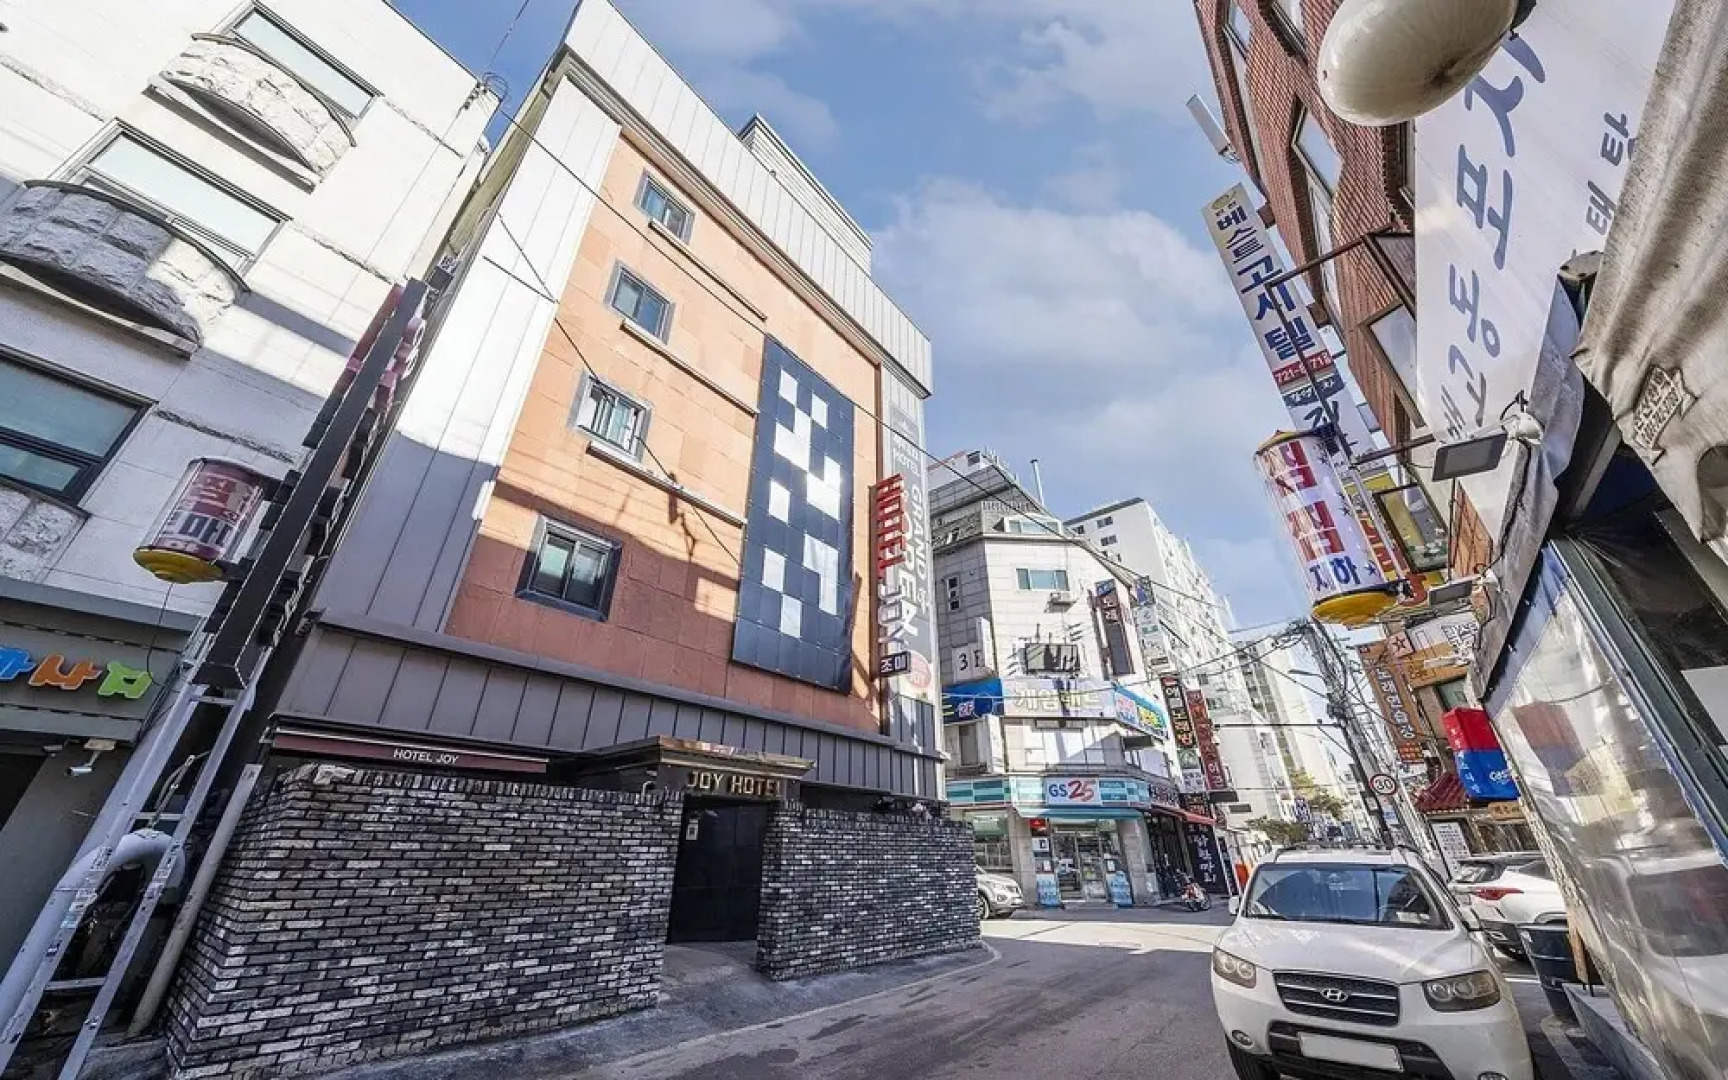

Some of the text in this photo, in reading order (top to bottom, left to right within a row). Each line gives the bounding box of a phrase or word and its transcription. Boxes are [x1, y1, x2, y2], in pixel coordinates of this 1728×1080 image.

[877, 473, 909, 647] HOTEL JOY
[394, 747, 459, 765] HOTEL JOY
[687, 769, 782, 798] JOY HOTEL
[1050, 780, 1096, 801] GS25
[1376, 778, 1395, 792] 30
